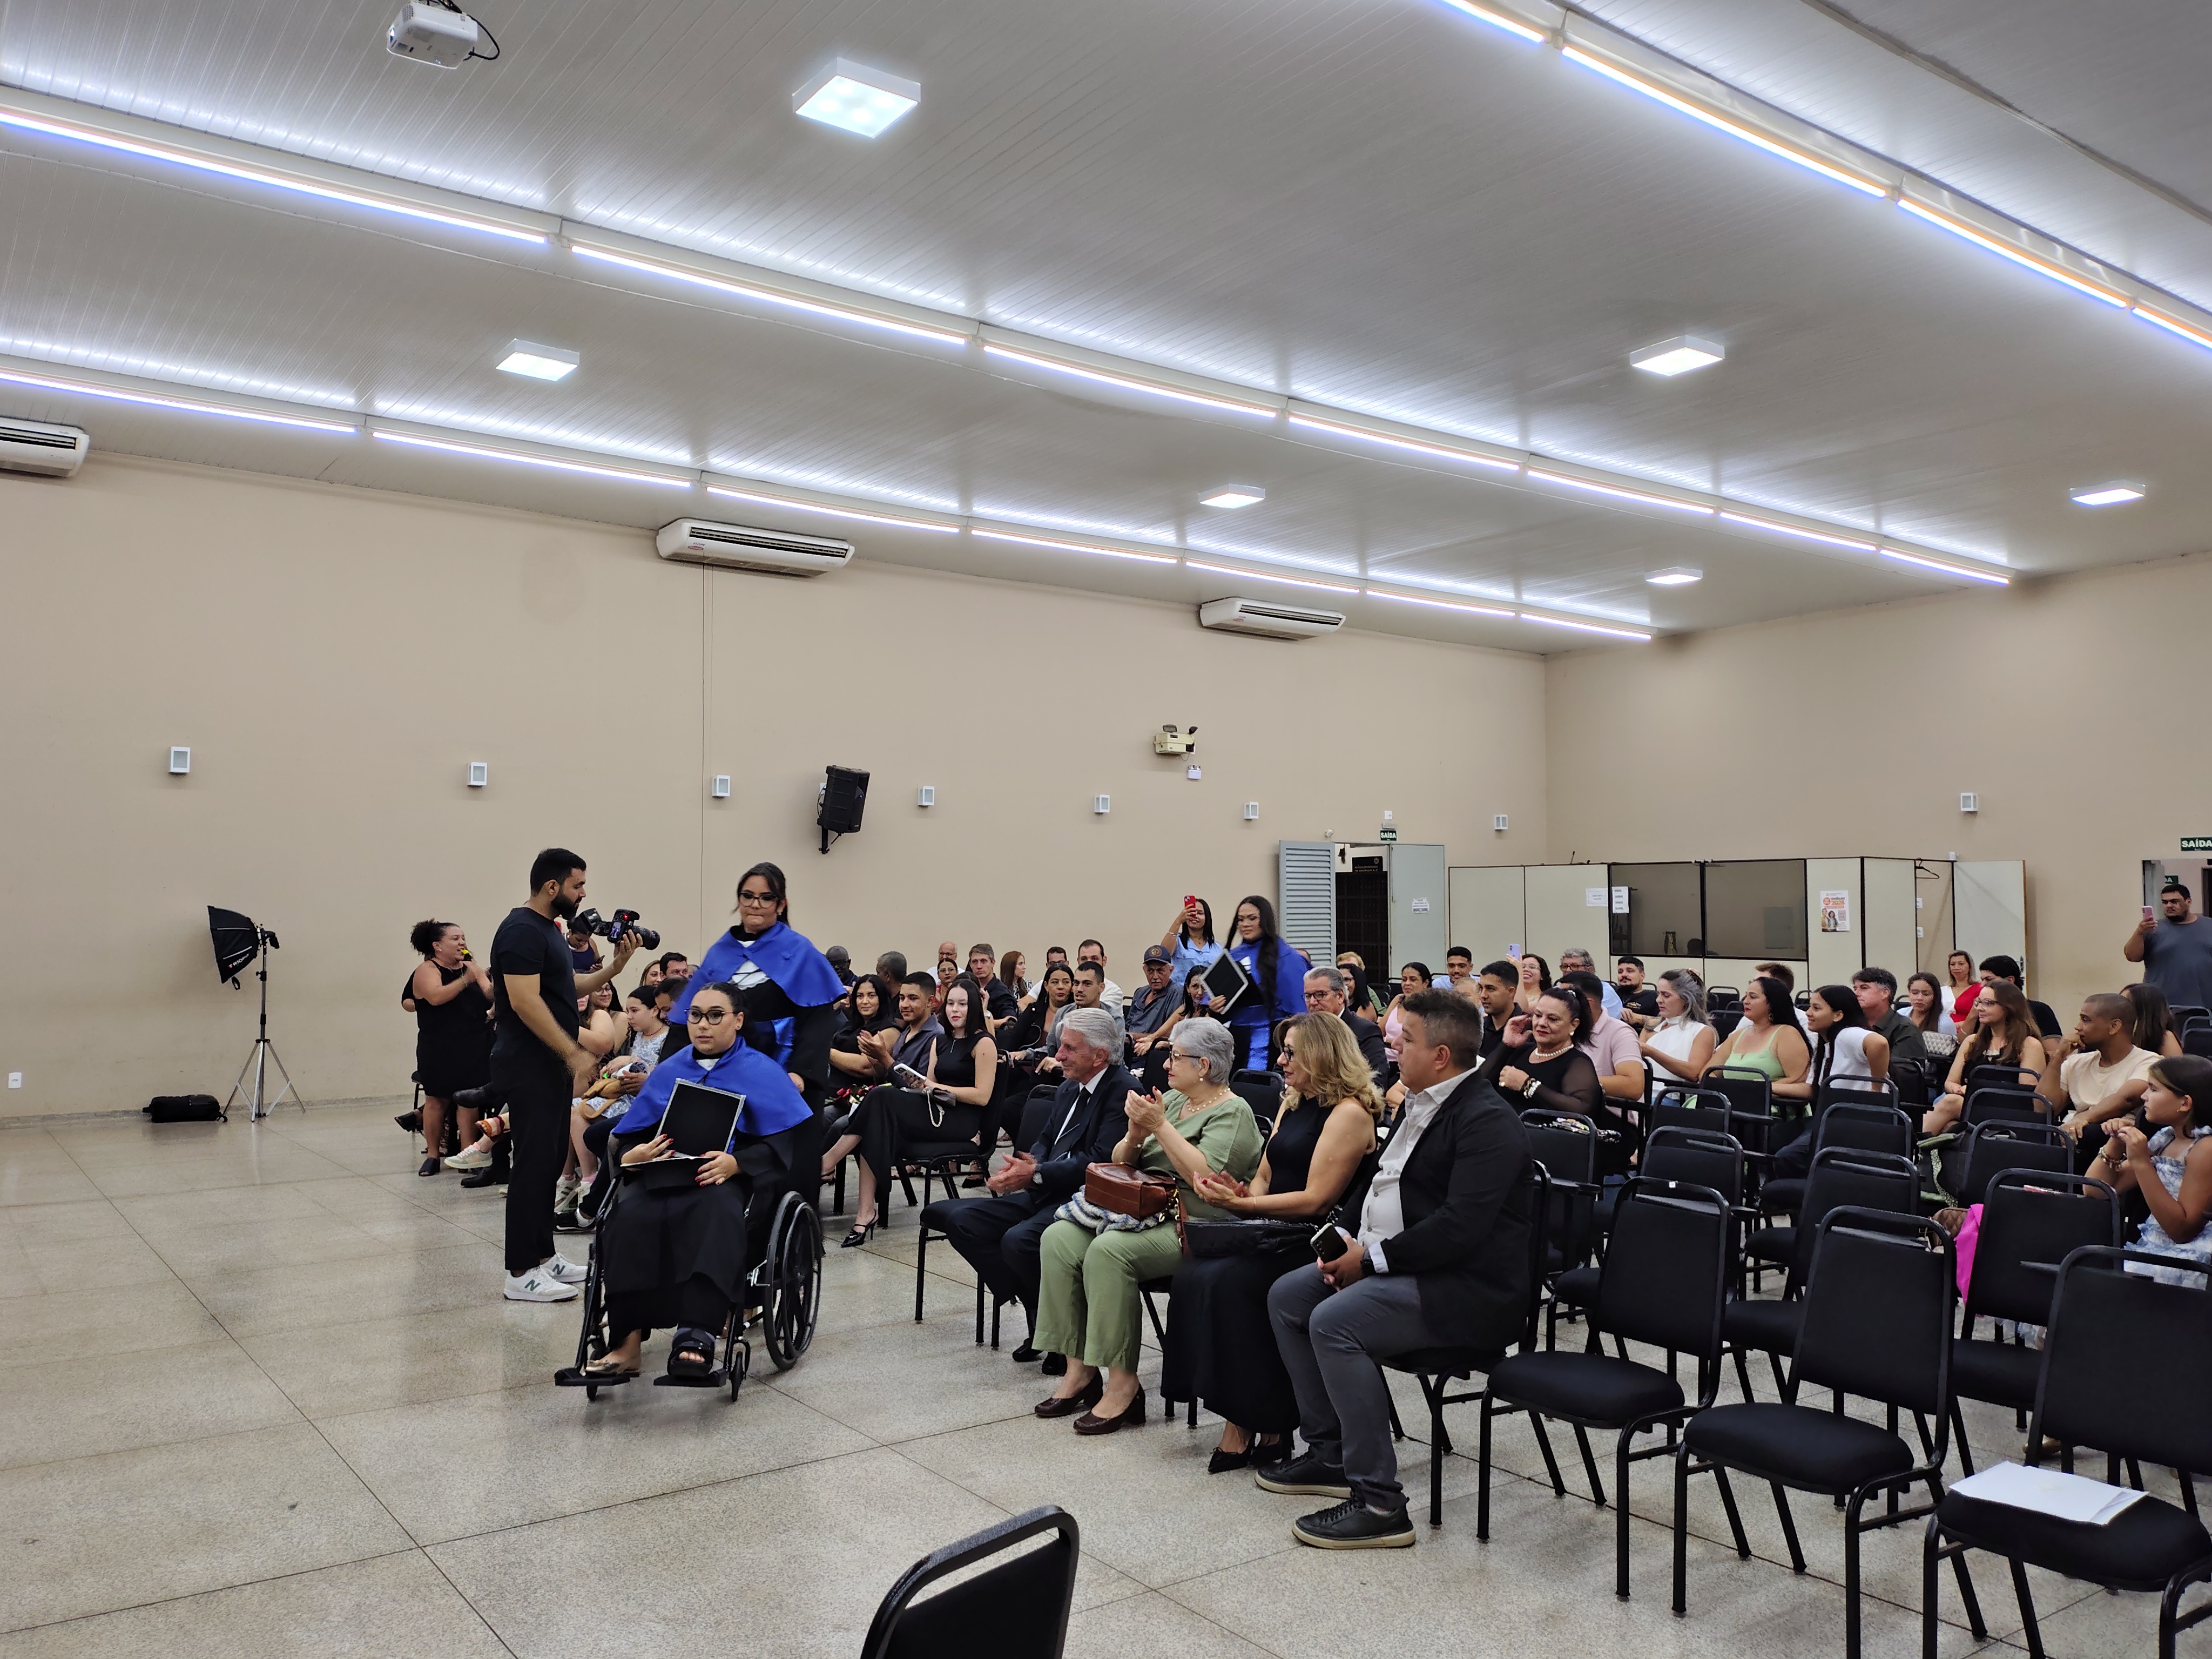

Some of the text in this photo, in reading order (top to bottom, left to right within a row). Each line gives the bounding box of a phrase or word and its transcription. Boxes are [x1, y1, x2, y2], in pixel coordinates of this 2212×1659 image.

[2181, 839, 2212, 848] SAÍDA
[552, 1263, 565, 1275] N
[524, 1279, 541, 1291] N
